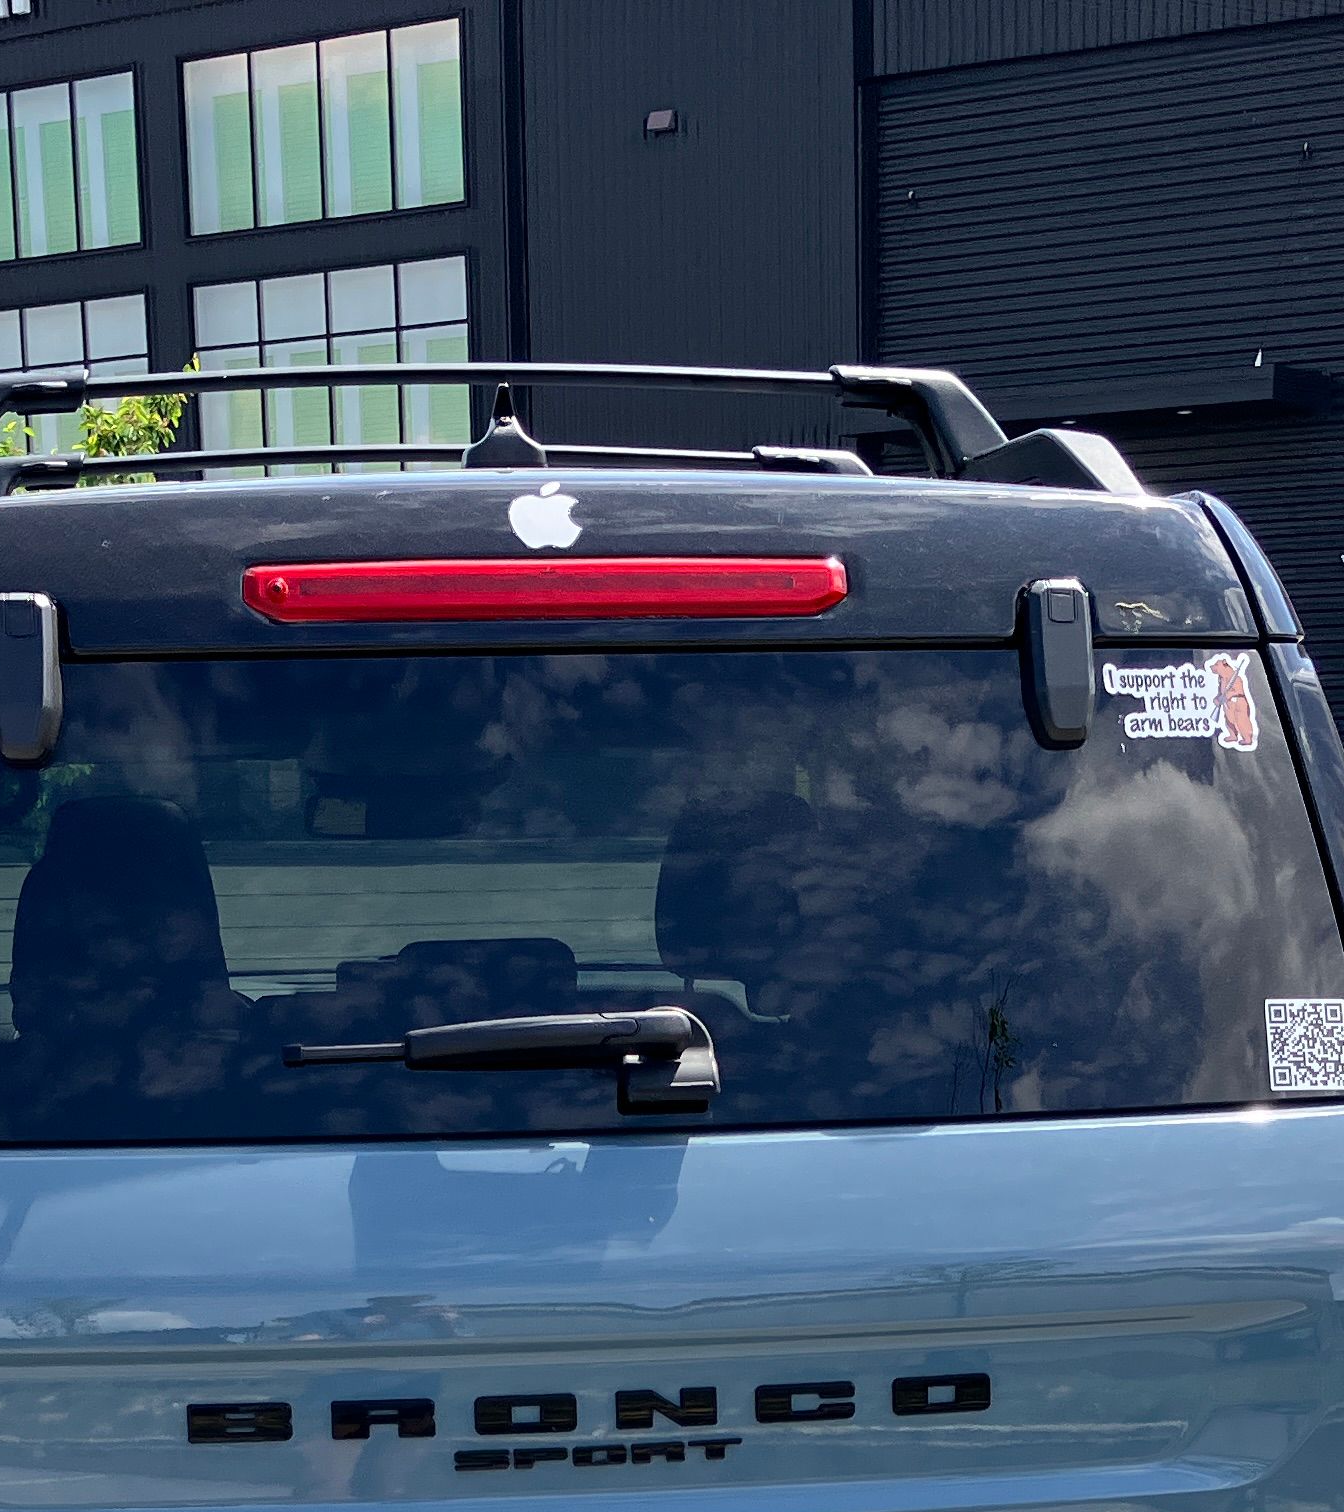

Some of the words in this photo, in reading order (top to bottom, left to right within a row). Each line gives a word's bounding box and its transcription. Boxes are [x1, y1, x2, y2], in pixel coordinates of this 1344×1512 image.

[1108, 669, 1115, 689] I
[1119, 671, 1176, 692] support
[1180, 669, 1206, 689] the
[1149, 691, 1188, 713] right
[1191, 693, 1207, 711] to
[1129, 717, 1164, 732] arm
[1168, 714, 1210, 732] bears
[186, 1372, 992, 1444] BRONCO
[453, 1437, 743, 1471] SPORT
